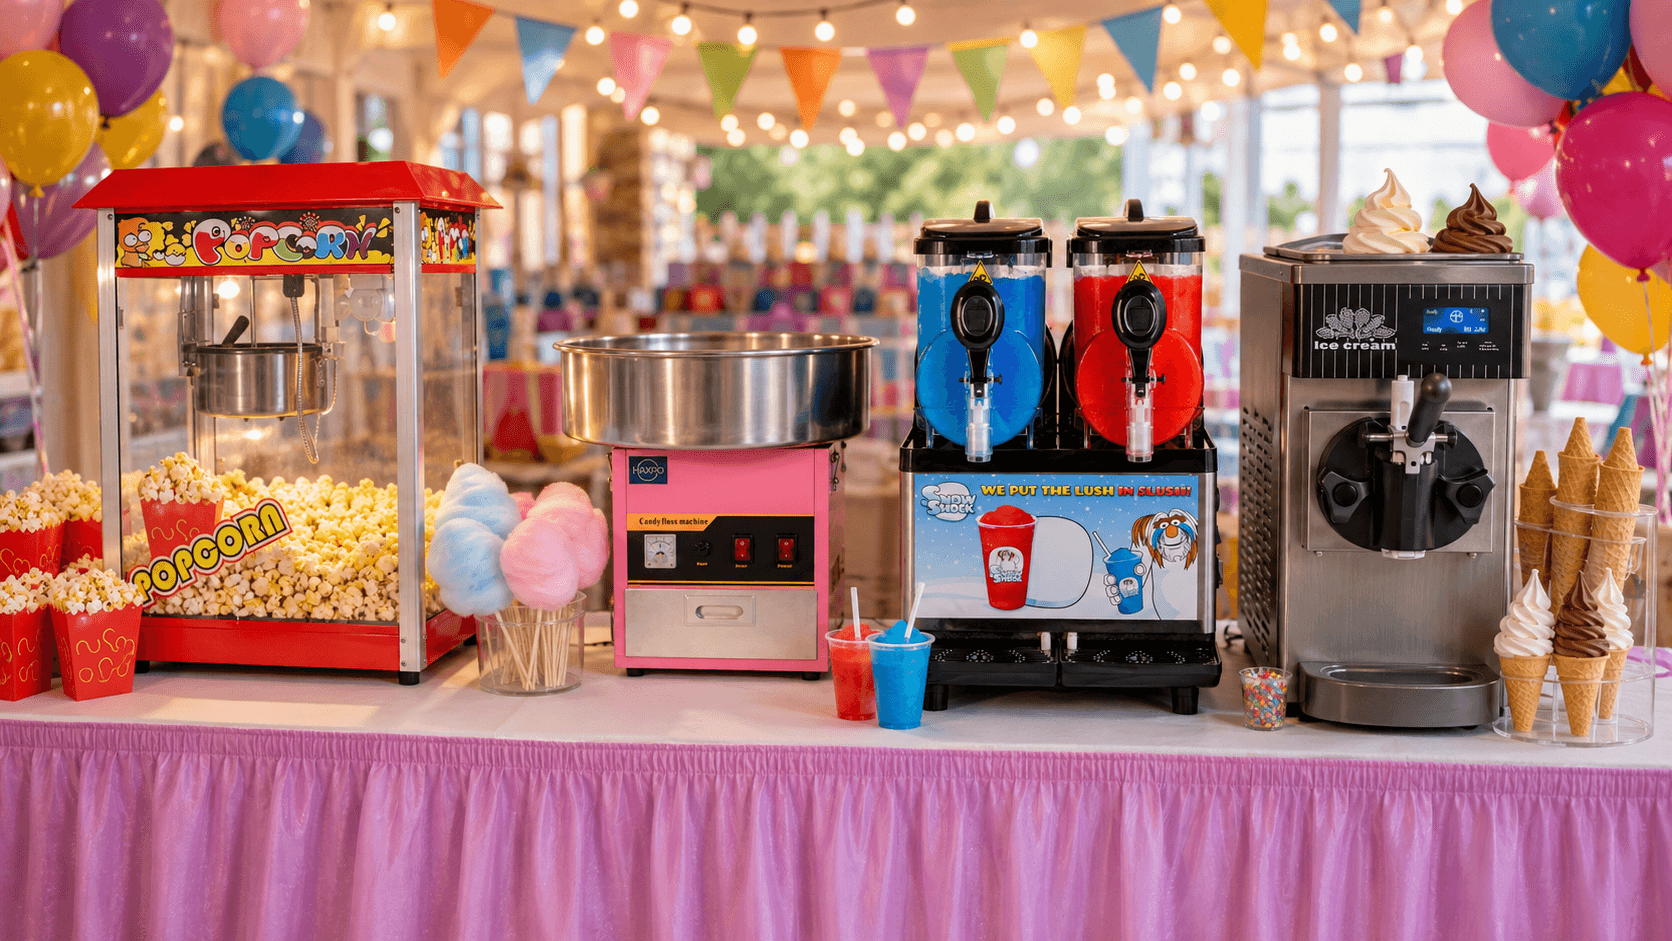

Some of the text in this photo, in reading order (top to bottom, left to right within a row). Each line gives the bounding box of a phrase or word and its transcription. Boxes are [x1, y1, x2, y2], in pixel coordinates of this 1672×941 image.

[193, 218, 376, 265] POPCORN
[1314, 341, 1396, 350] Ice cream
[980, 485, 1006, 497] WE
[1009, 485, 1038, 497] PUT
[1041, 485, 1072, 497] THE
[1074, 485, 1114, 497] LUSH
[1117, 485, 1135, 497] IN
[639, 517, 709, 527] Candy floss machine
[131, 502, 288, 606] POPCORN
